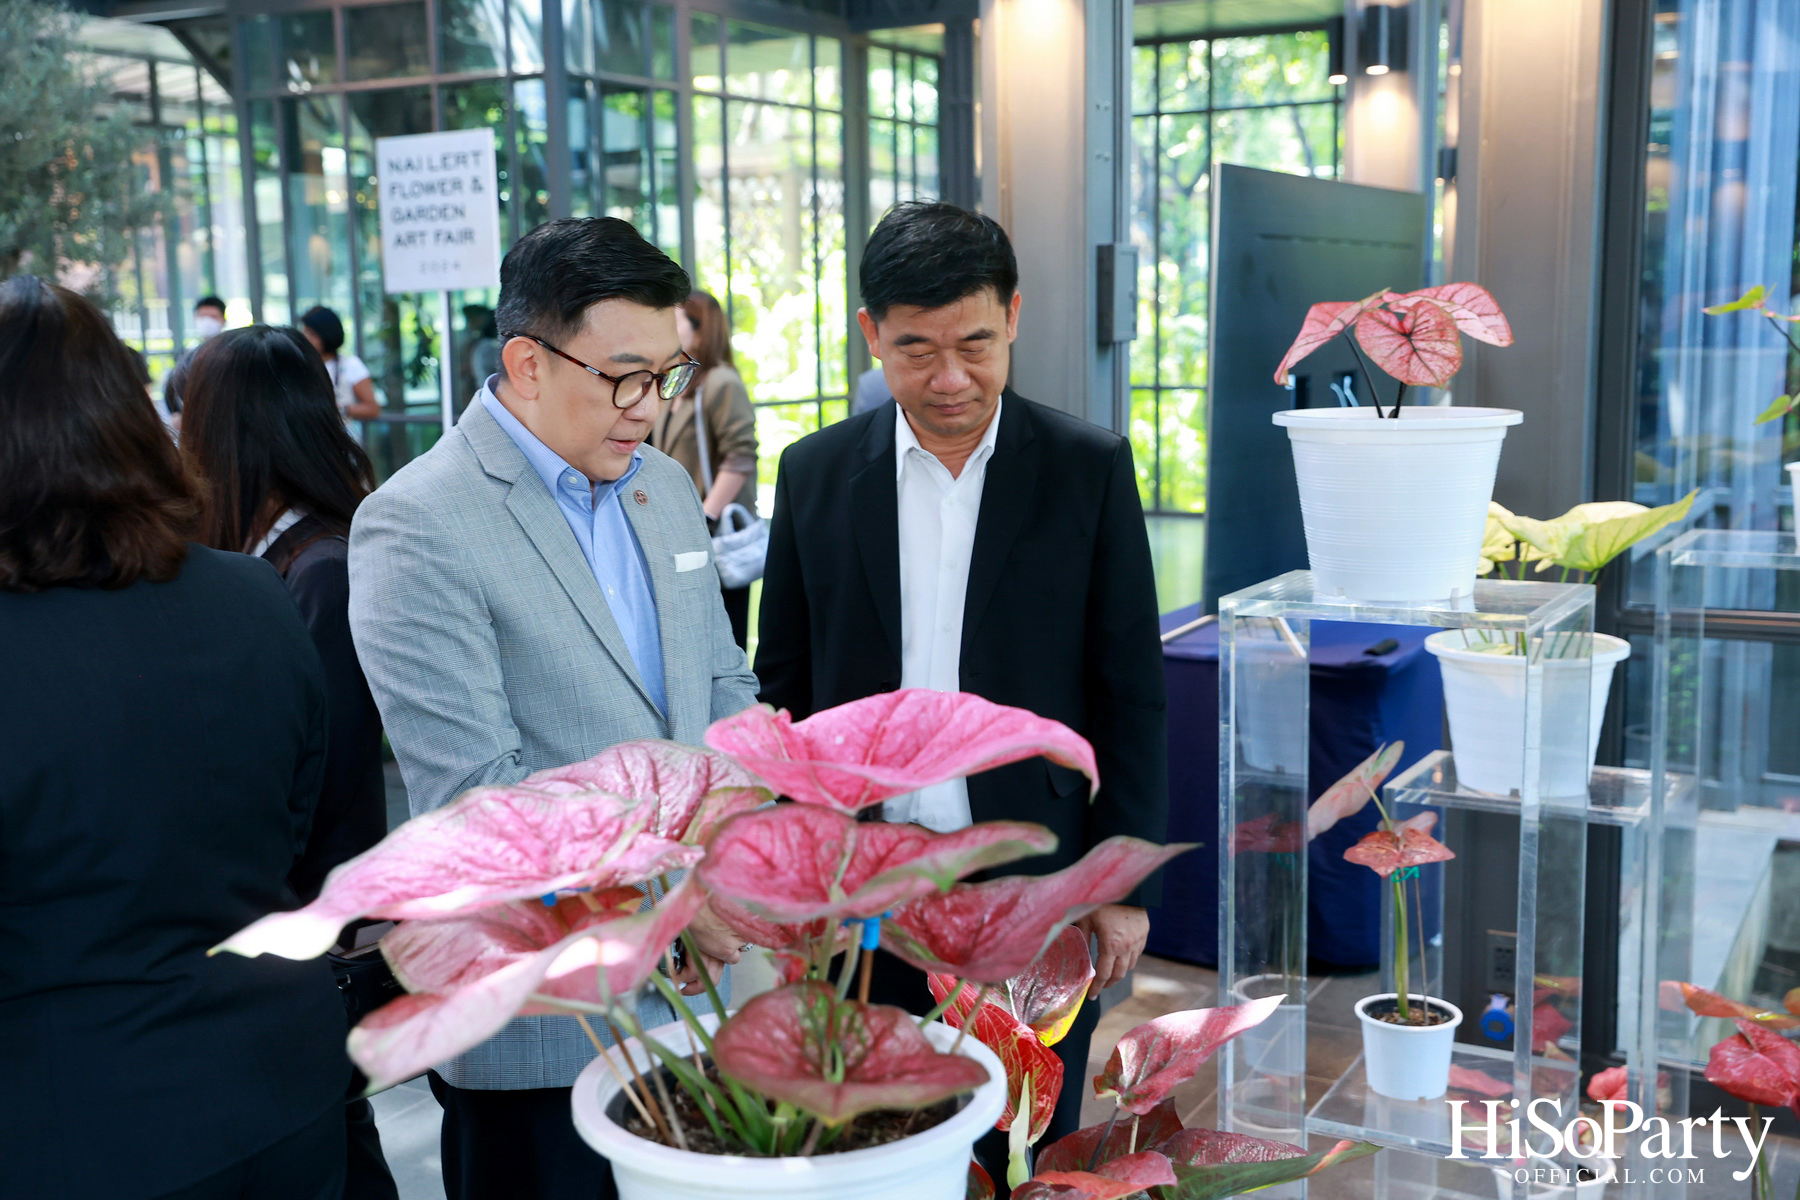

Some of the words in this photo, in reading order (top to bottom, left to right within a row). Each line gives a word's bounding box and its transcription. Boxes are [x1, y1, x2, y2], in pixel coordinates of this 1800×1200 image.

[387, 155, 423, 173] NAI
[427, 151, 482, 172] LERT
[389, 178, 464, 199] FLOWER
[470, 176, 485, 195] &
[390, 204, 466, 225] GARDEN
[395, 229, 428, 248] ART
[433, 227, 476, 246] FAIR
